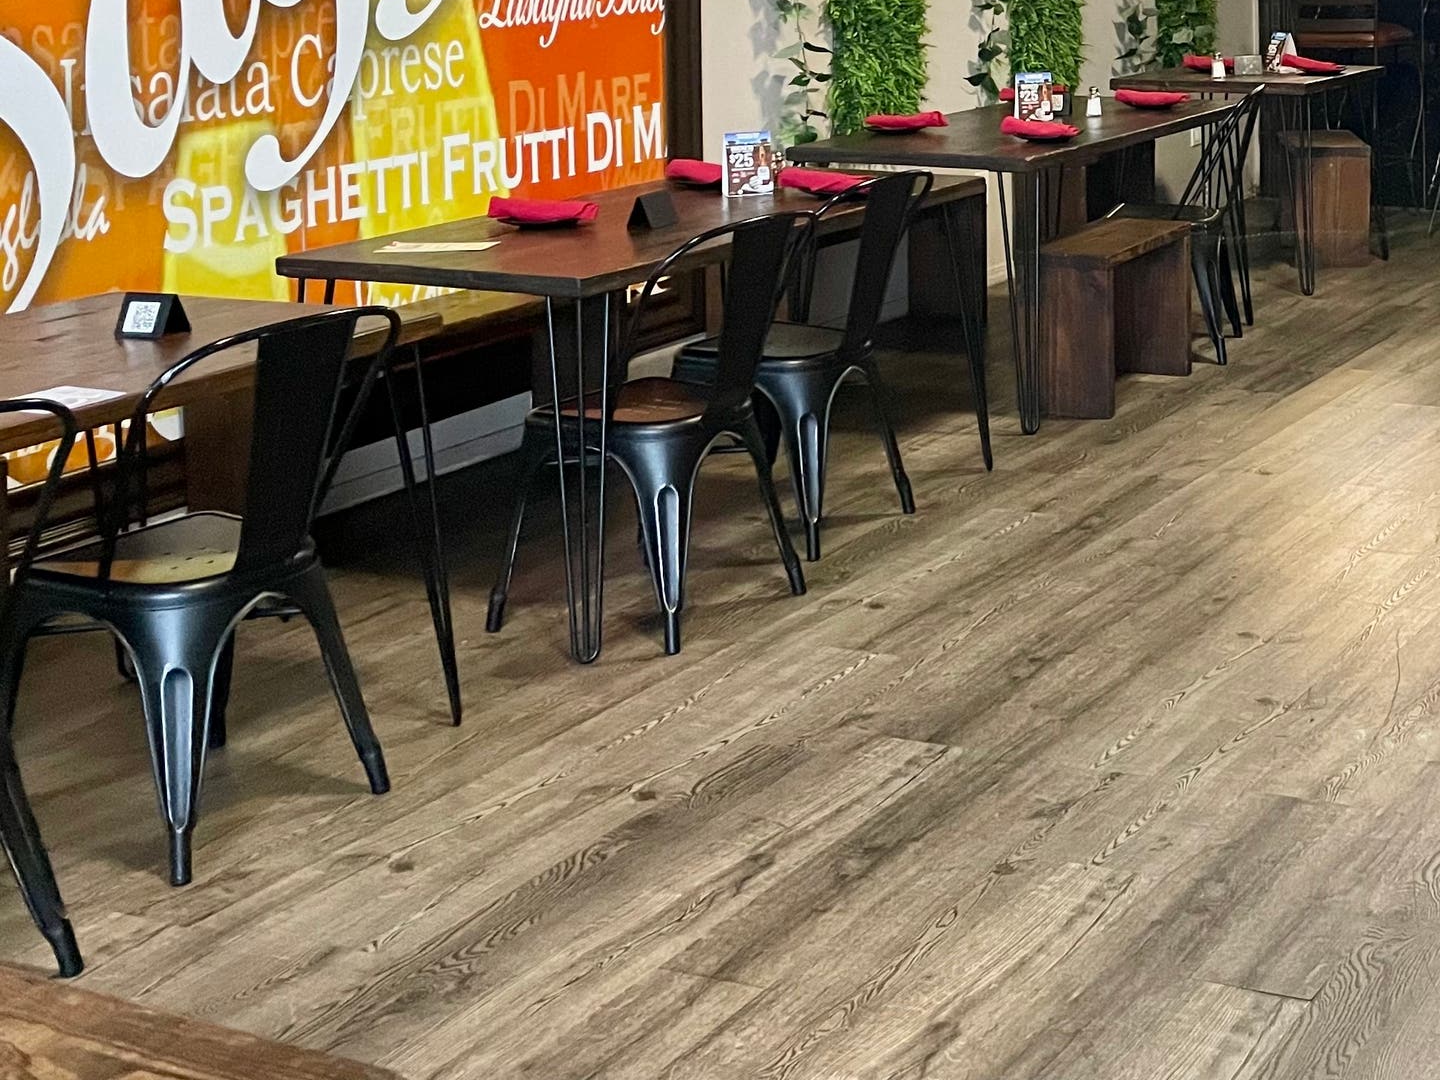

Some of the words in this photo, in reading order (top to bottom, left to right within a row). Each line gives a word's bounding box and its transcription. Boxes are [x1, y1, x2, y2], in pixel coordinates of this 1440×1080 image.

[161, 152, 429, 254] SPAGHETTI
[442, 126, 577, 201] FRUTTI
[586, 110, 625, 174] DI
[729, 152, 754, 168] $25
